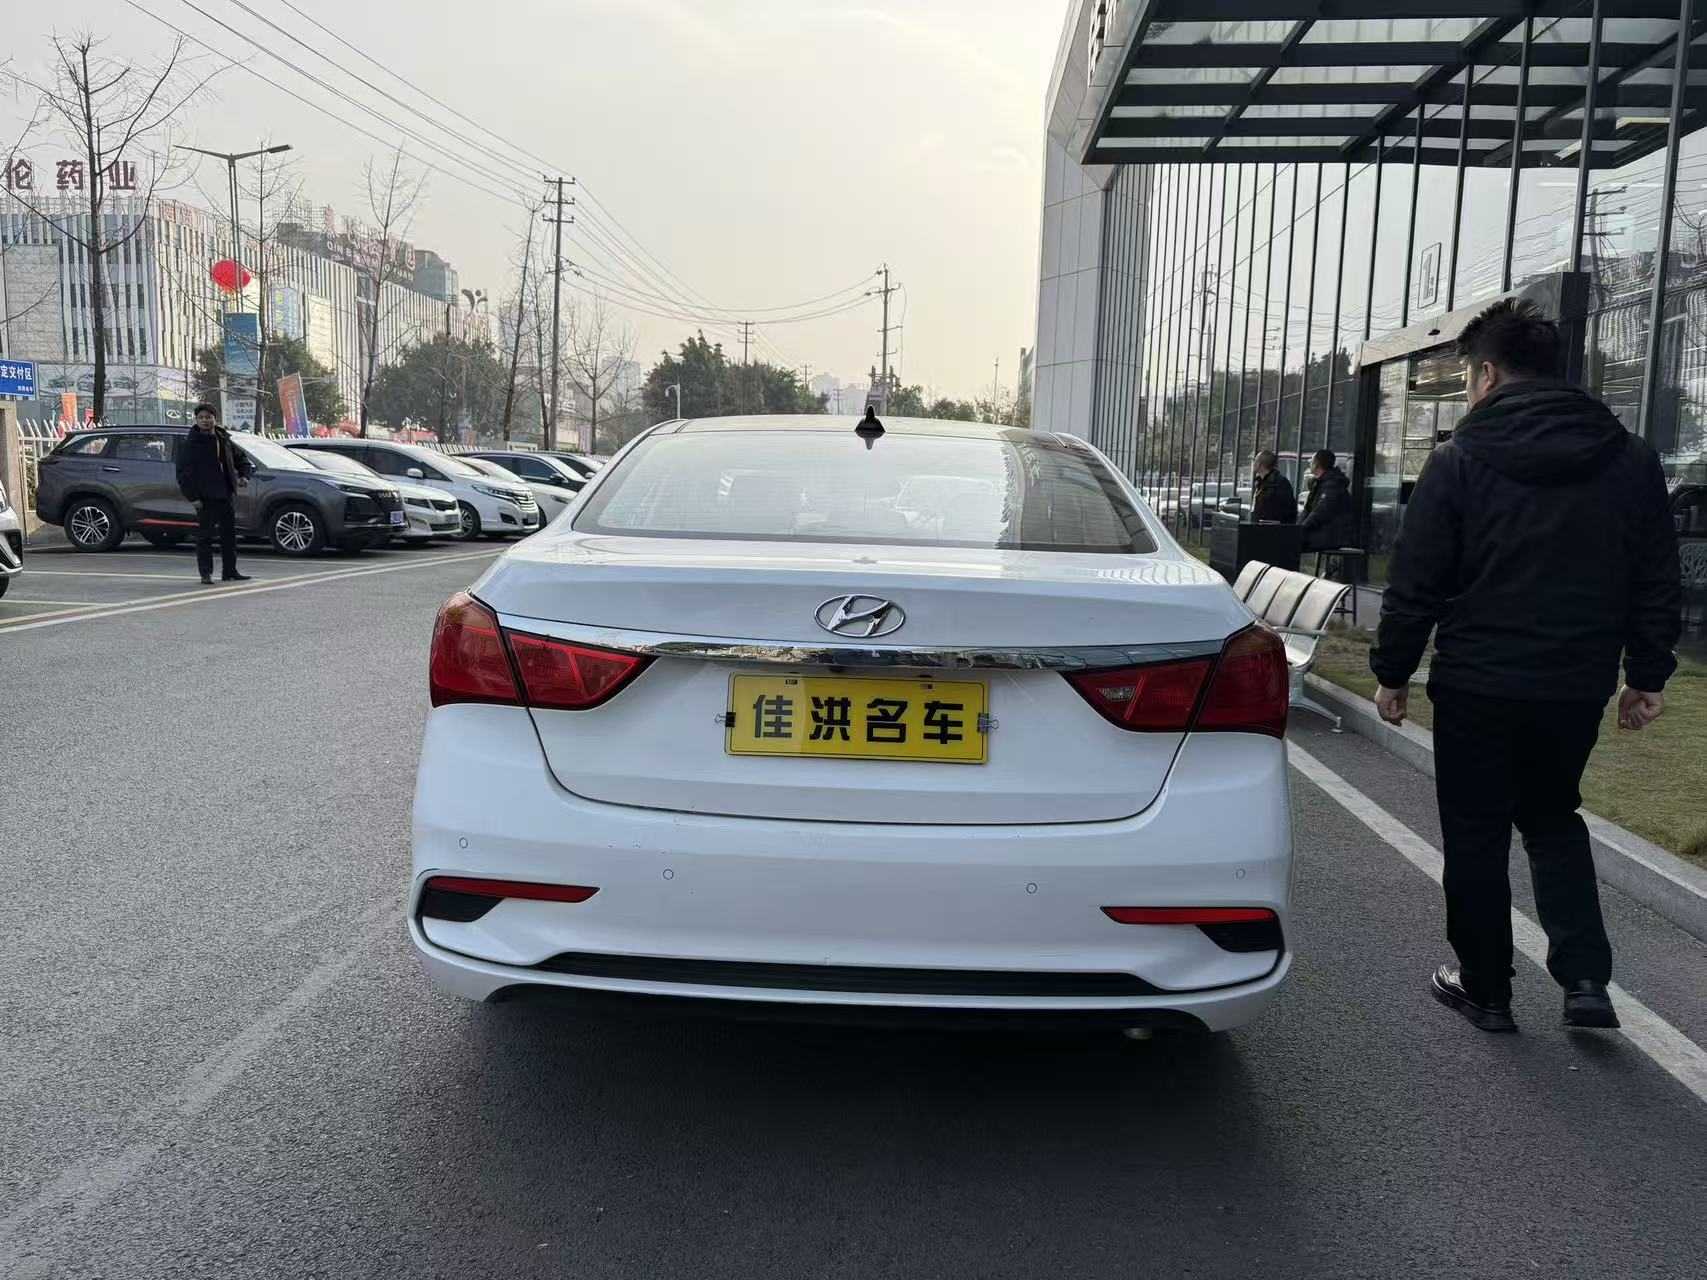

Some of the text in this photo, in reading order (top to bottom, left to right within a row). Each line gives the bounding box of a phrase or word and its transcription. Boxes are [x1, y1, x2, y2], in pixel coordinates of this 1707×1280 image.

[6, 159, 136, 190] 伦药业
[753, 694, 964, 745] 佳洪名车
